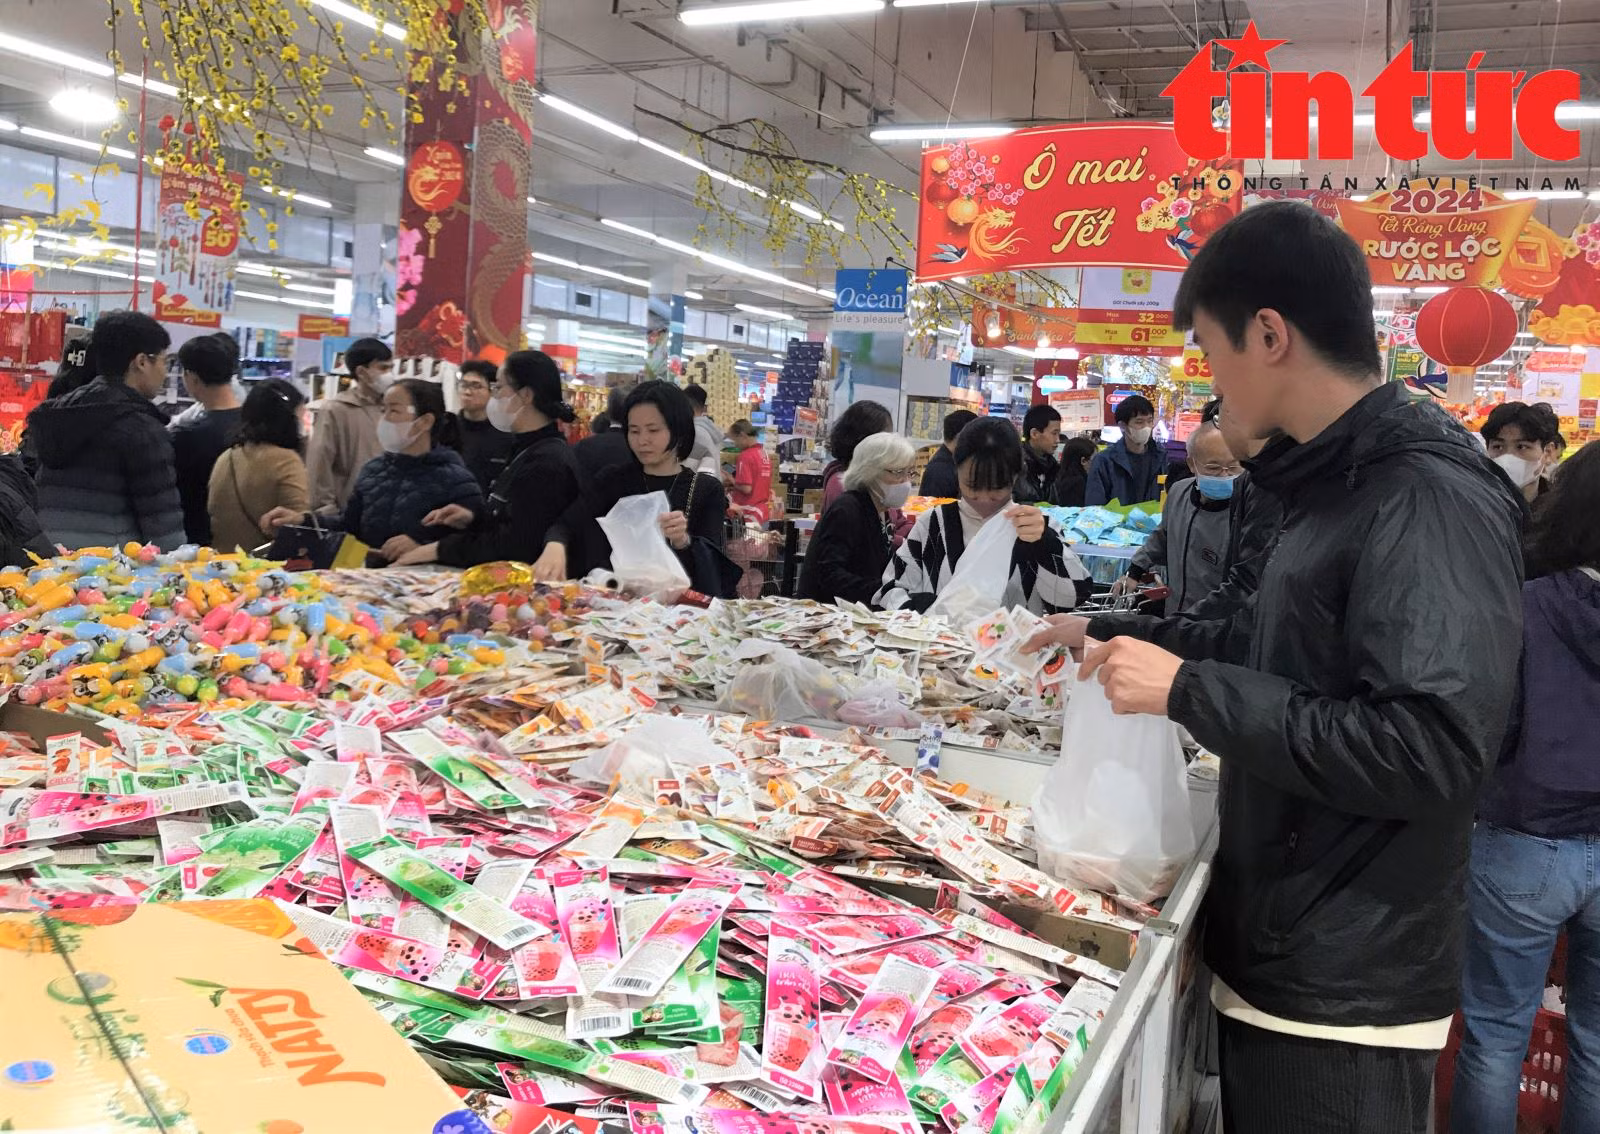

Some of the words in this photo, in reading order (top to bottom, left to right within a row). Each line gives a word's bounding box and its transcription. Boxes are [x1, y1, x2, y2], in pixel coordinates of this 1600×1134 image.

[1023, 142, 1056, 190] Ô
[1067, 146, 1148, 185] mai
[1390, 188, 1483, 214] 2024
[1051, 207, 1117, 254] Tết
[1379, 214, 1399, 232] Tết
[1402, 217, 1443, 239] Rồng
[1448, 216, 1487, 236] Vàng
[1363, 237, 1439, 260] RƯỚC
[1445, 234, 1501, 263] LỘC
[1391, 259, 1466, 282] VÀNG
[837, 287, 904, 309] Ocean
[835, 314, 860, 323] Life's
[863, 314, 903, 324] pleasure
